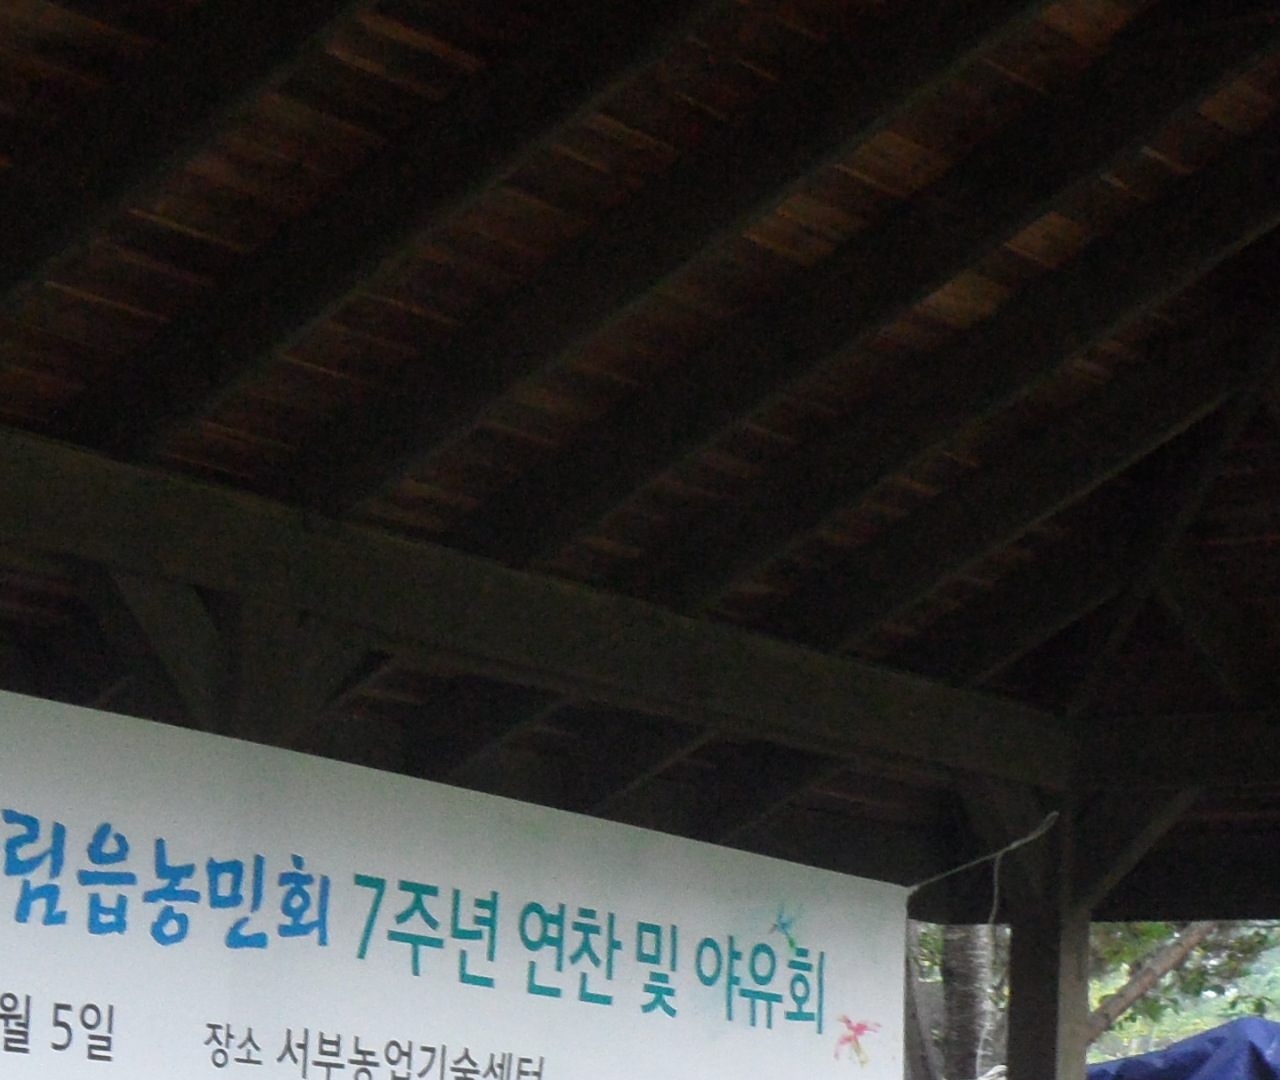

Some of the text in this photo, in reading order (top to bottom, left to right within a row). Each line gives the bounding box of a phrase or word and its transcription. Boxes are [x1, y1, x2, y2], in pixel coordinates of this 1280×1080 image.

[354, 873, 500, 989] 7주년
[518, 901, 624, 1007] 연찬
[636, 921, 679, 1018] 및
[695, 934, 826, 1035] 야유회
[49, 1001, 116, 1064] 5일
[202, 1021, 263, 1070] 장소
